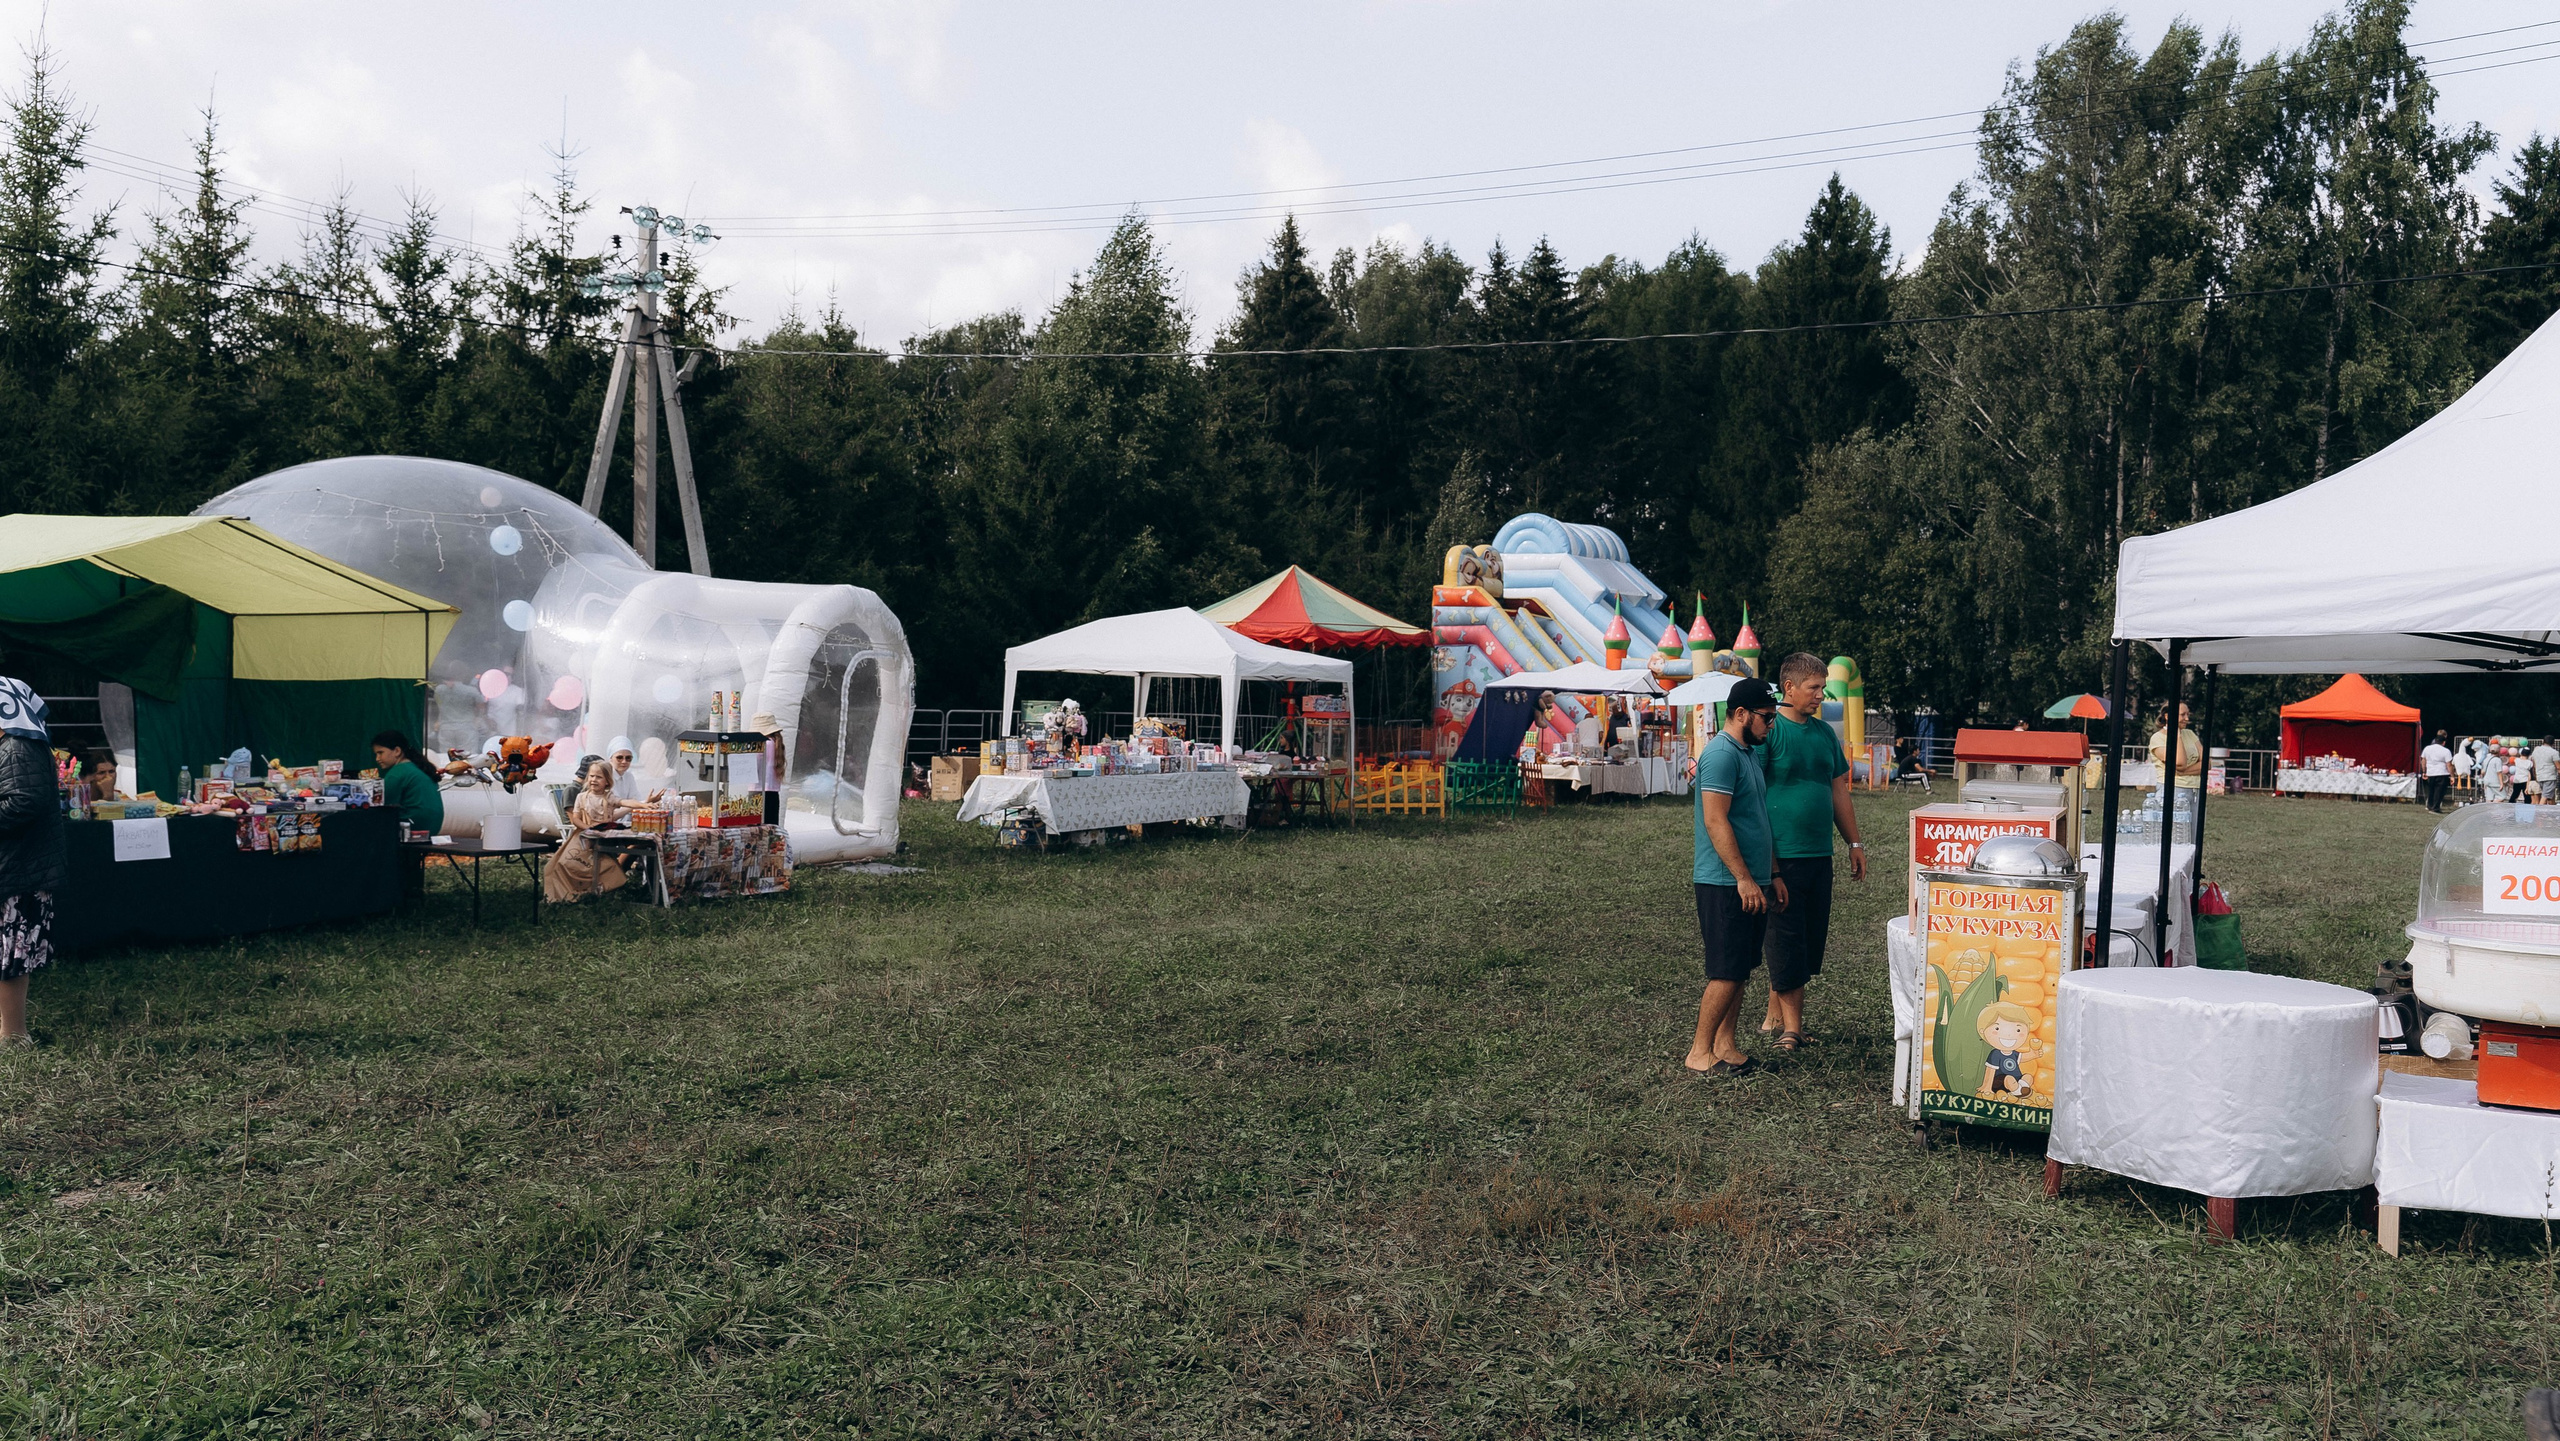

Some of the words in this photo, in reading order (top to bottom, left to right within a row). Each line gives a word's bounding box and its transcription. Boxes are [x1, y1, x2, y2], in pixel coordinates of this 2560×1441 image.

[1934, 842, 1975, 865] ЯБЛ
[2486, 844, 2559, 859] СЛАДКАЯ
[1933, 888, 2057, 915] ГОРЯЧАЯ
[2500, 874, 2560, 902] 200
[1927, 914, 2061, 942] КУКУРУЗА
[1923, 1092, 2050, 1125] КУКУРУЗКИН
